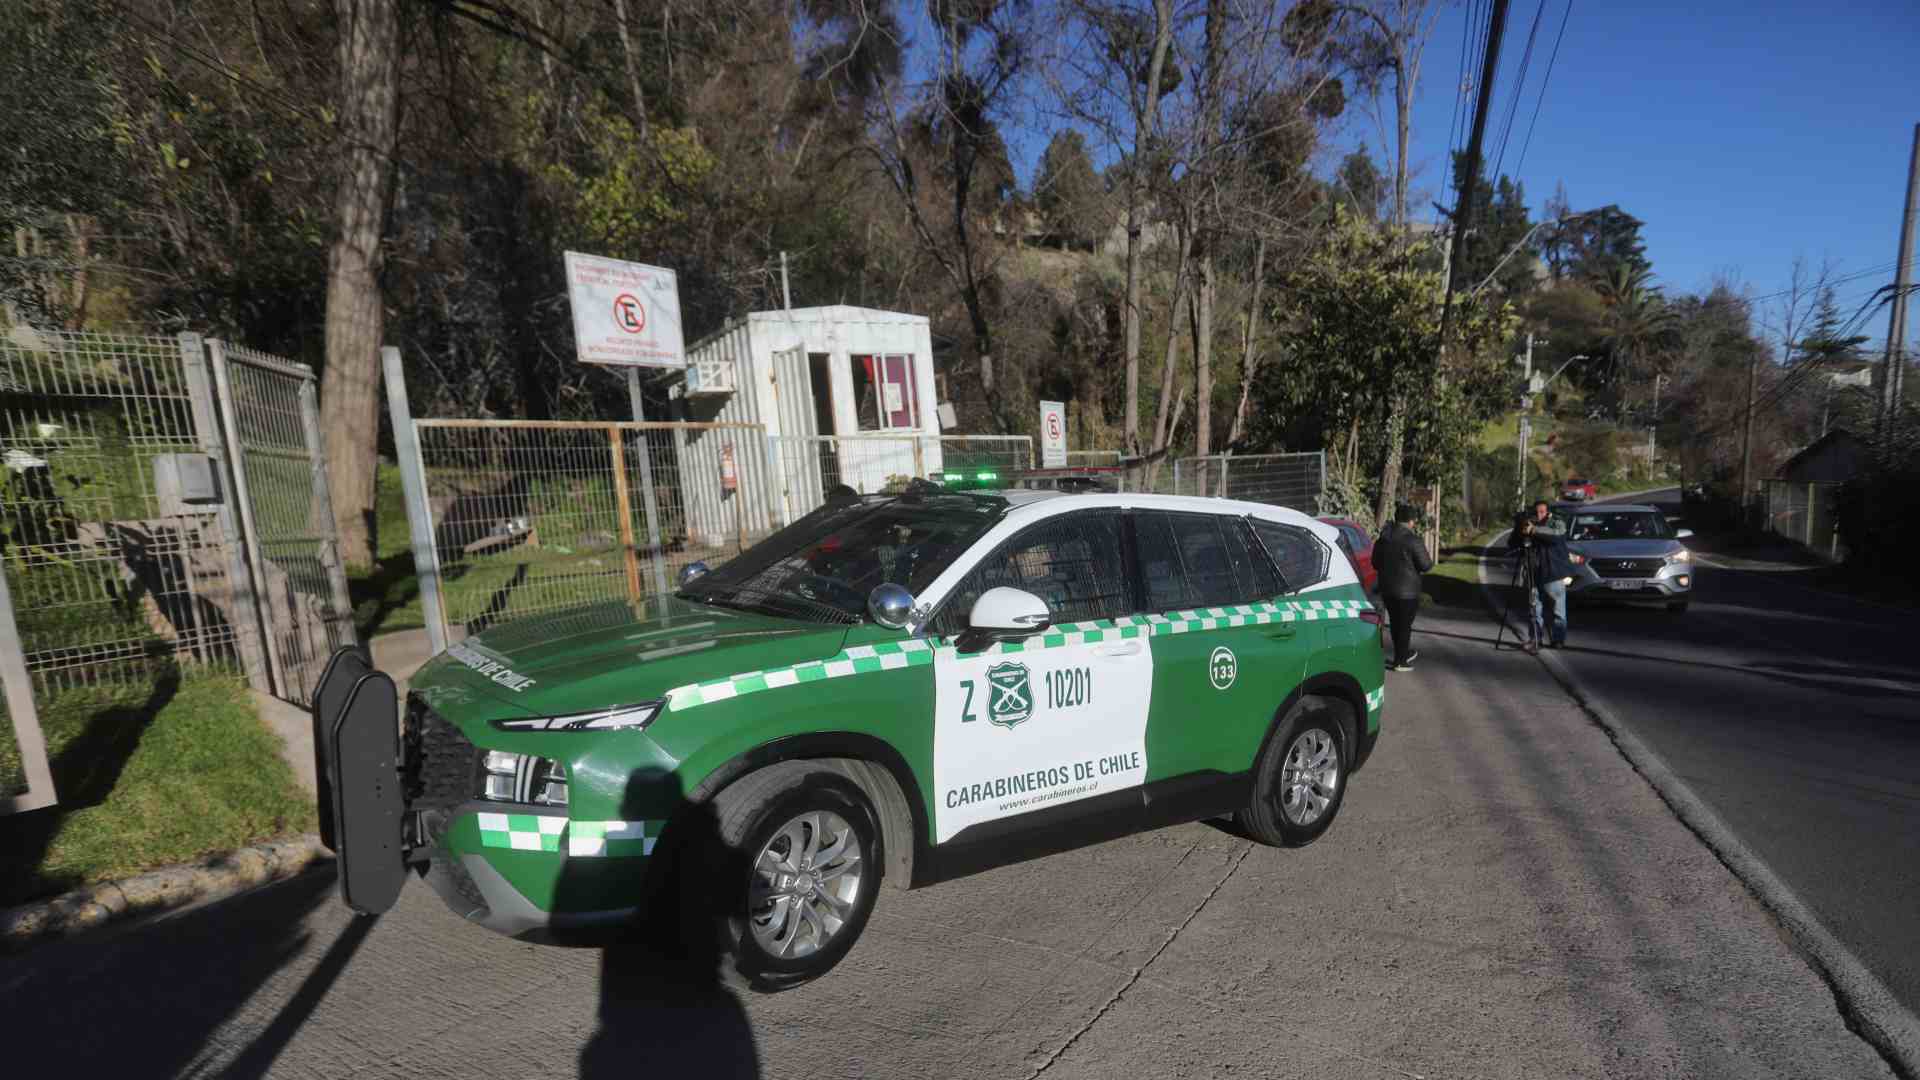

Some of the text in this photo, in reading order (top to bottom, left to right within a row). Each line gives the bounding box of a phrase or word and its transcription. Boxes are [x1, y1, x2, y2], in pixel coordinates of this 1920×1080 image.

[1213, 664, 1234, 680] 133
[959, 667, 1091, 723] Z 10201
[946, 752, 1140, 809] CARABINEROS DE CHILE
[999, 782, 1099, 811] www.carabineros.cl
